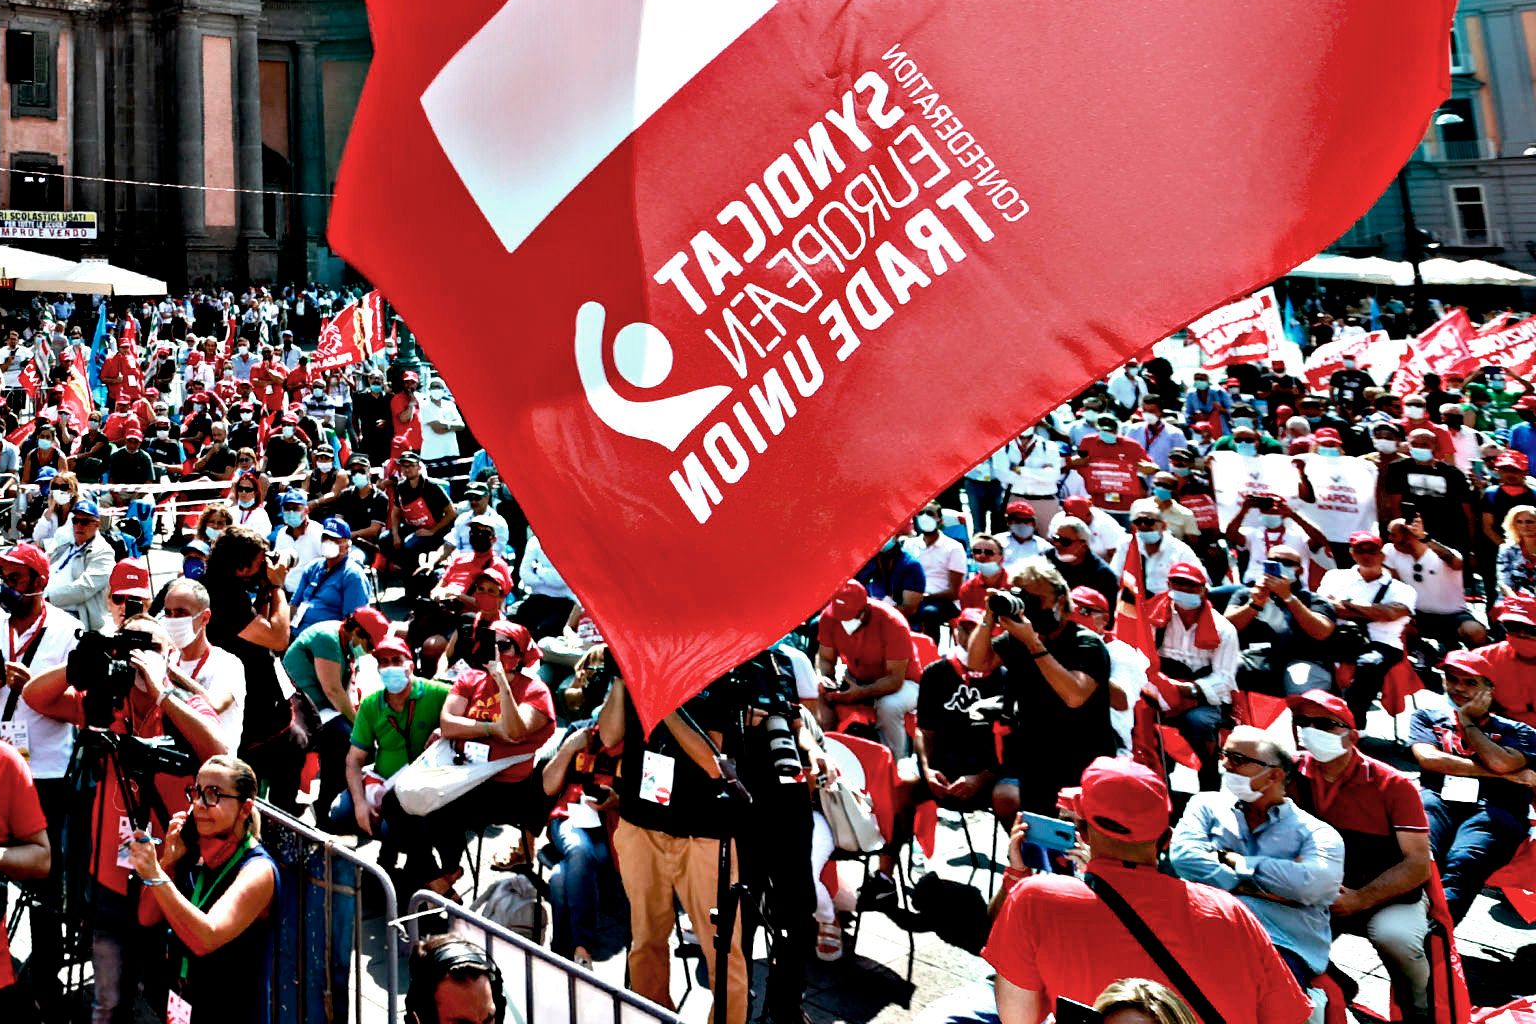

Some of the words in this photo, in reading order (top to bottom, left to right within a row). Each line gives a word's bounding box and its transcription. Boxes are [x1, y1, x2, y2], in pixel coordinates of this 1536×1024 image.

[9, 212, 60, 221] SCOLASTICI
[63, 213, 86, 222] USATI
[39, 228, 44, 236] E
[49, 228, 87, 237] VENDO
